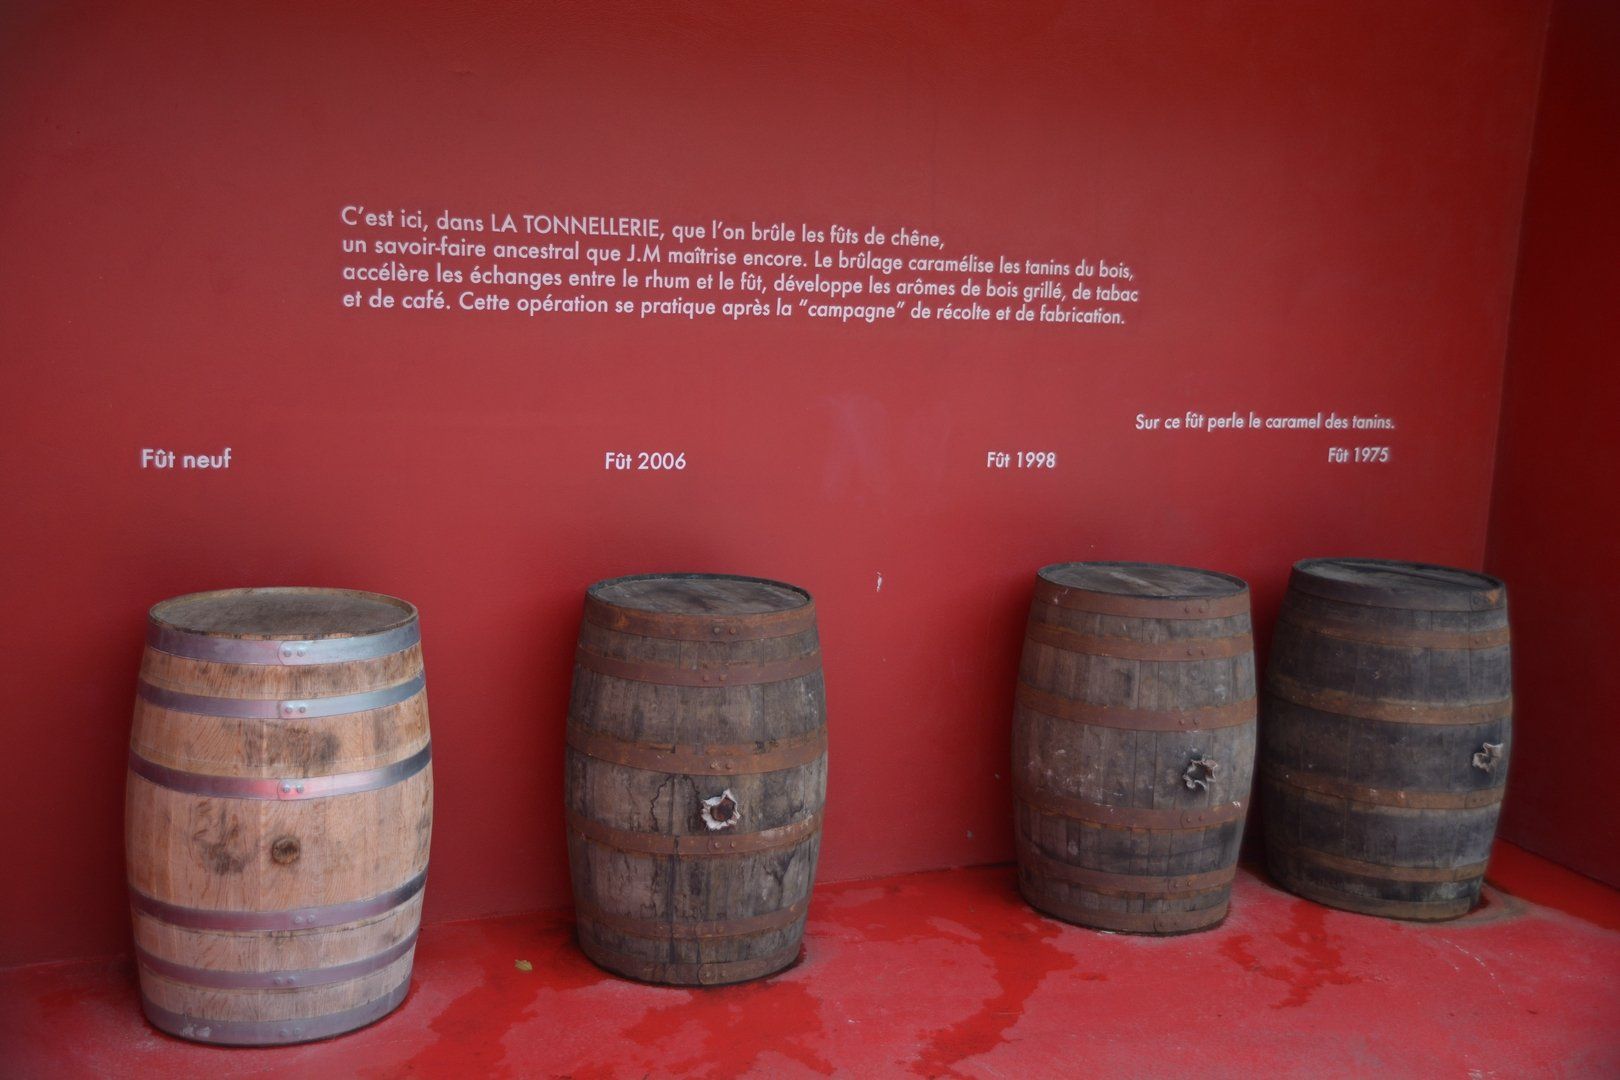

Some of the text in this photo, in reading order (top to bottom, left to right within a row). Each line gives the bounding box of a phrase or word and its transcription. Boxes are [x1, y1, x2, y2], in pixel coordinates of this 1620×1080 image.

[341, 205, 945, 251] C'est ici, dans LA TONNELLERIE, que l'on brûle les fûts de chêne,
[342, 235, 1134, 282] un savoir-faire ancestral que J.M maîtrise encore. Le brûlage caramélise les tanins du bois,
[342, 260, 1139, 303] accélère les échanges entre le rhum et le fût, développe les arômes de bois grillé, de tabac
[342, 290, 363, 308] et
[368, 287, 395, 309] de
[401, 288, 451, 310] café.
[458, 291, 510, 311] Cette
[516, 293, 609, 317] opération
[614, 300, 635, 314] se
[640, 296, 716, 320] pratique
[721, 298, 771, 321] après
[776, 297, 793, 317] la
[910, 300, 932, 319] de
[936, 301, 991, 321] récolte
[995, 306, 1012, 321] et
[1015, 303, 1035, 322] de
[1039, 303, 1125, 325] fabrication.
[1135, 410, 1396, 433] Sur ce fût perle le caramel des tanins.
[140, 446, 232, 470] Fût neuf
[605, 451, 687, 471] Fût 2006
[986, 451, 1057, 469] Fût 1998
[1327, 446, 1390, 464] Fût 1975
